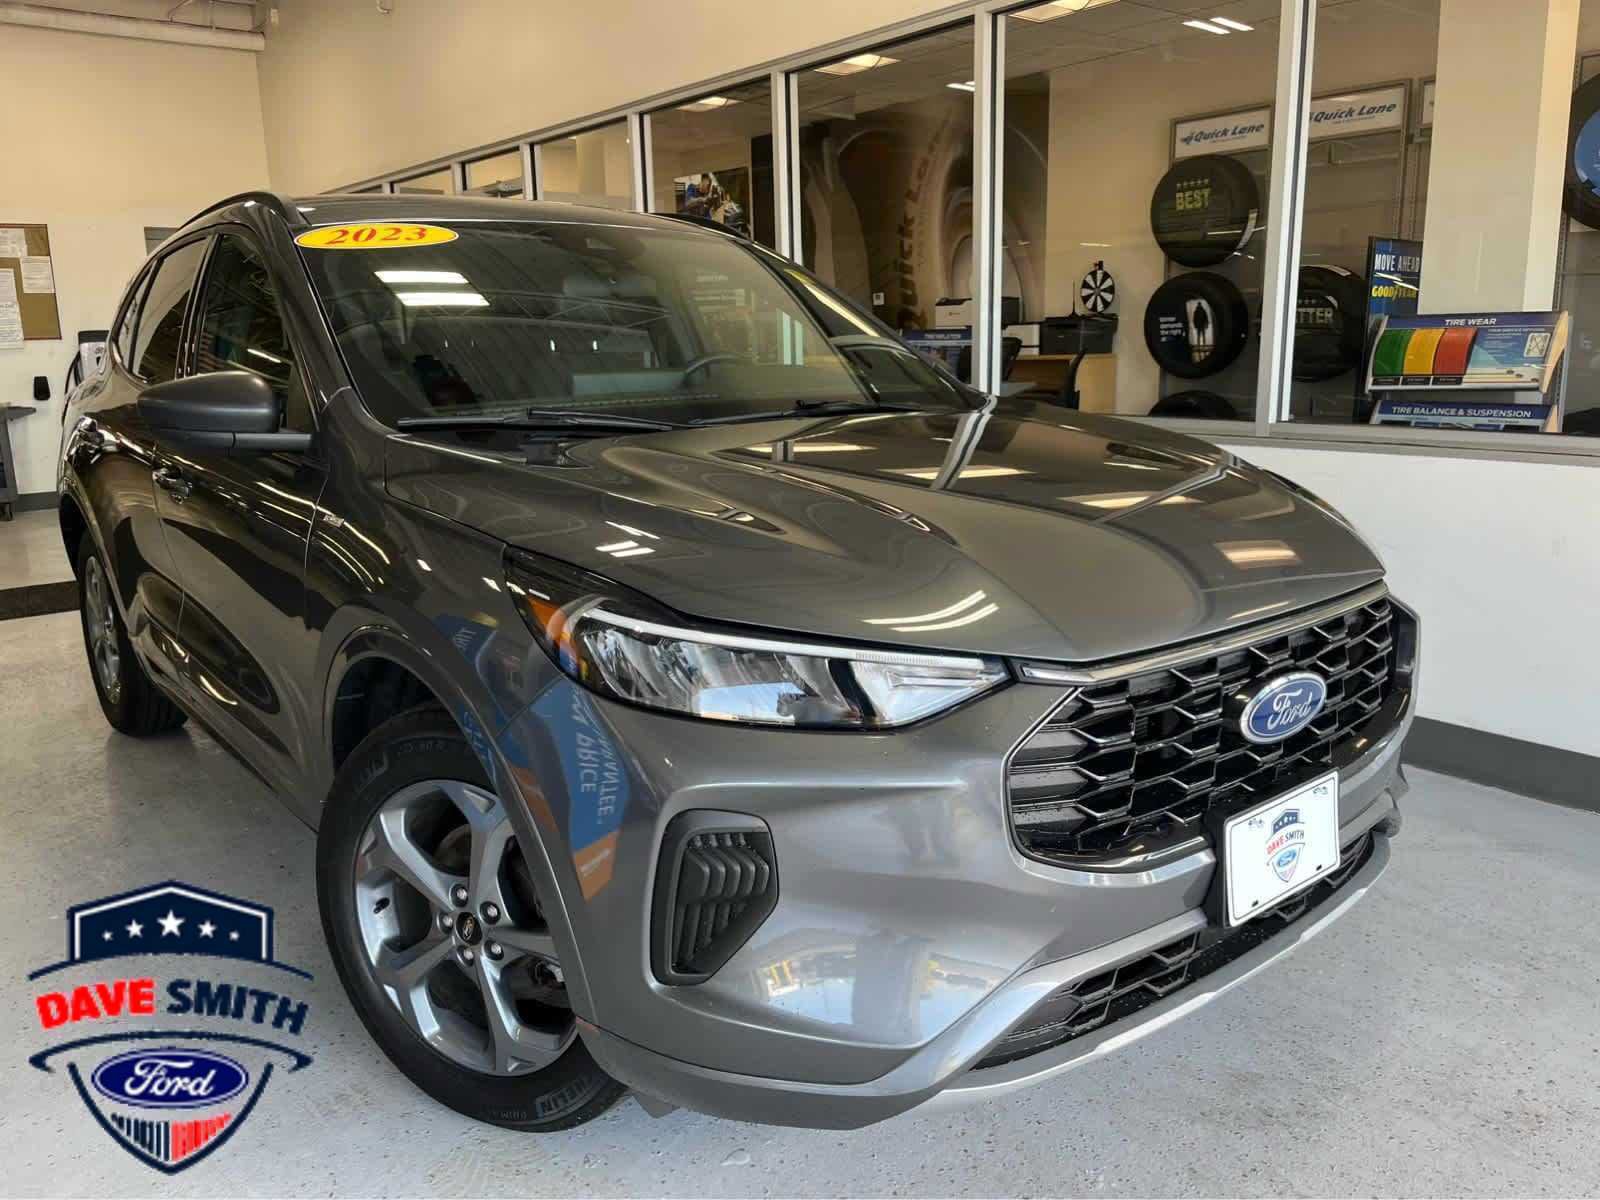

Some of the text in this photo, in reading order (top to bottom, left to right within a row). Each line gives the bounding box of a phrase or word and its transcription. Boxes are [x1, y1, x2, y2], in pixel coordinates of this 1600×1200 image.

[1314, 108, 1355, 123] Quick
[1358, 103, 1397, 116] Lane
[1194, 126, 1229, 142] Quick
[1231, 123, 1265, 136] Lane
[1175, 188, 1212, 211] BEST
[324, 227, 428, 245] 2023
[1374, 253, 1420, 273] MOVE AHEAD
[1444, 317, 1497, 326] TIRE WEAR
[1392, 406, 1532, 418] TIRE BALANCE & SUSPENSION
[1267, 689, 1312, 729] Ford
[1266, 830, 1305, 855] DAVE SMITH
